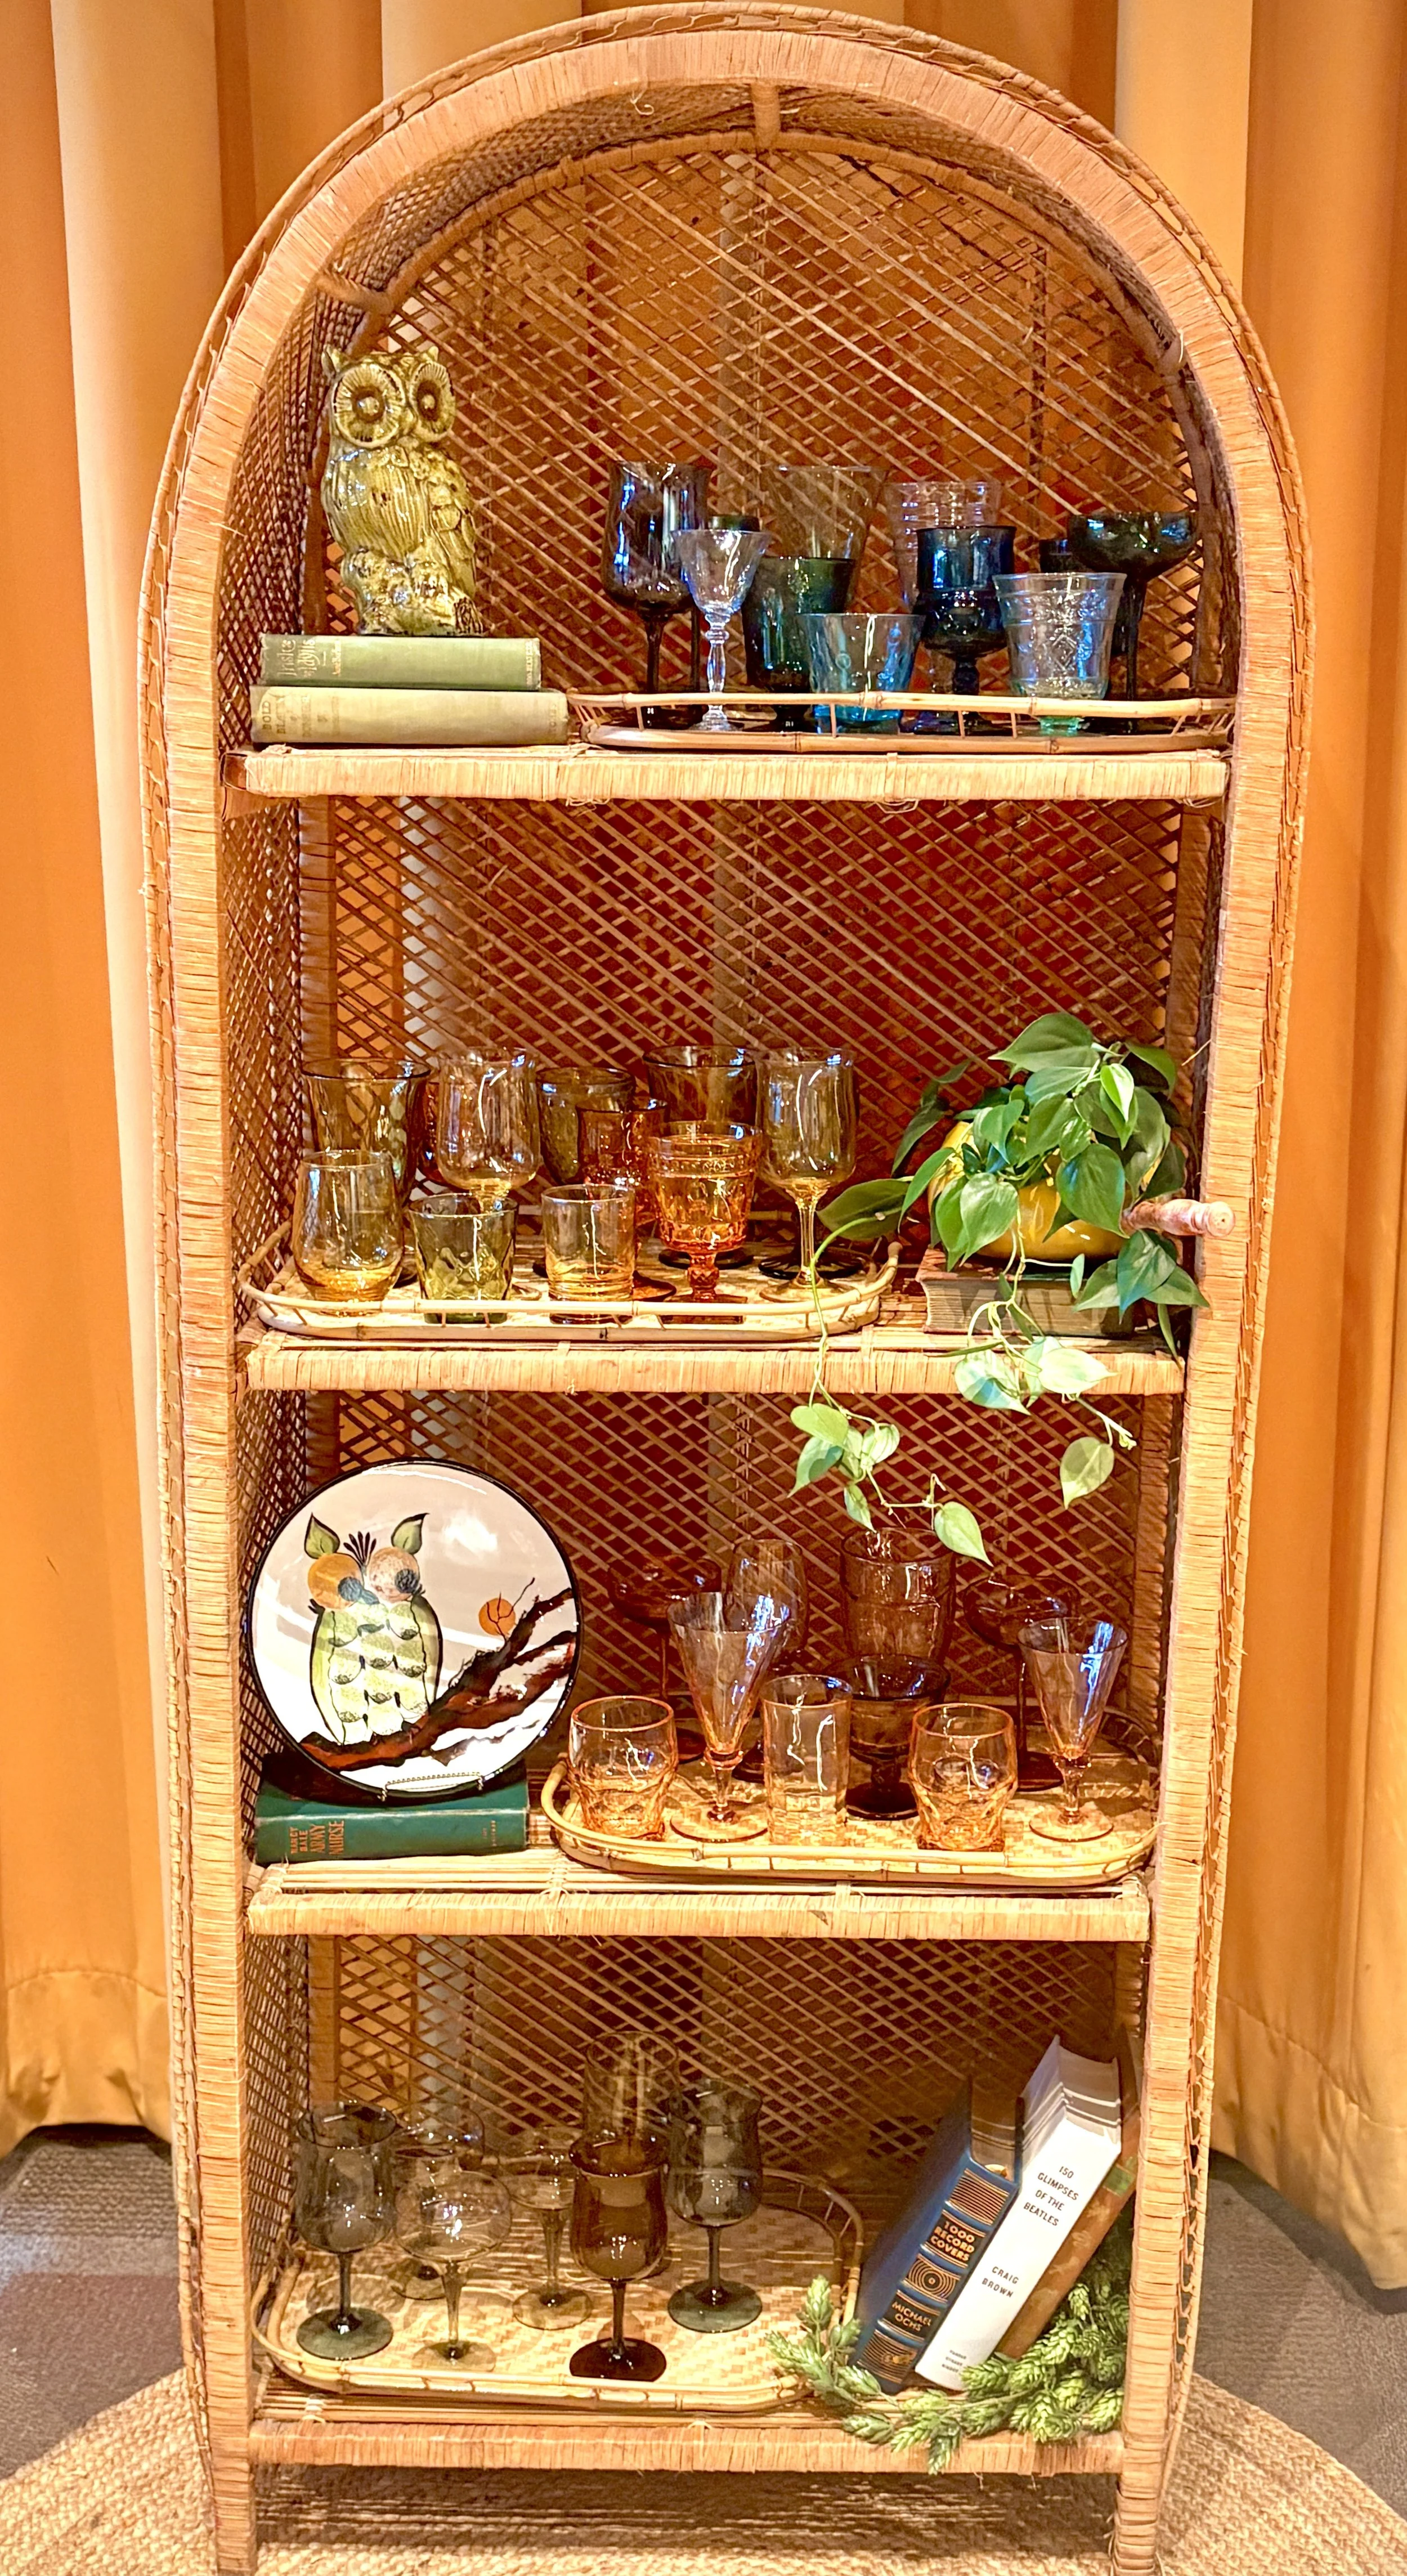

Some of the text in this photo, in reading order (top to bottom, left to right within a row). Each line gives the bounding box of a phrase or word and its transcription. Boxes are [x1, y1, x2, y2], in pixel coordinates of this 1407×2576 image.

[297, 639, 320, 671] Idylls
[290, 1827, 298, 1854] NANCY
[309, 1825, 326, 1854] ARMY
[329, 1820, 344, 1855] NURSE
[1059, 2166, 1074, 2179] 150
[1037, 2172, 1079, 2201] GLIMPSES
[1035, 2189, 1065, 2211] OF THE
[1023, 2202, 1059, 2226] BEATLES
[934, 2226, 975, 2254] RECORD
[944, 2221, 975, 2243] 1000
[930, 2235, 970, 2261] COVERS
[982, 2278, 1014, 2298] BROWN
[992, 2266, 1019, 2284] CRAIG
[891, 2301, 932, 2327] MICHAEL
[895, 2313, 923, 2332] OCHS
